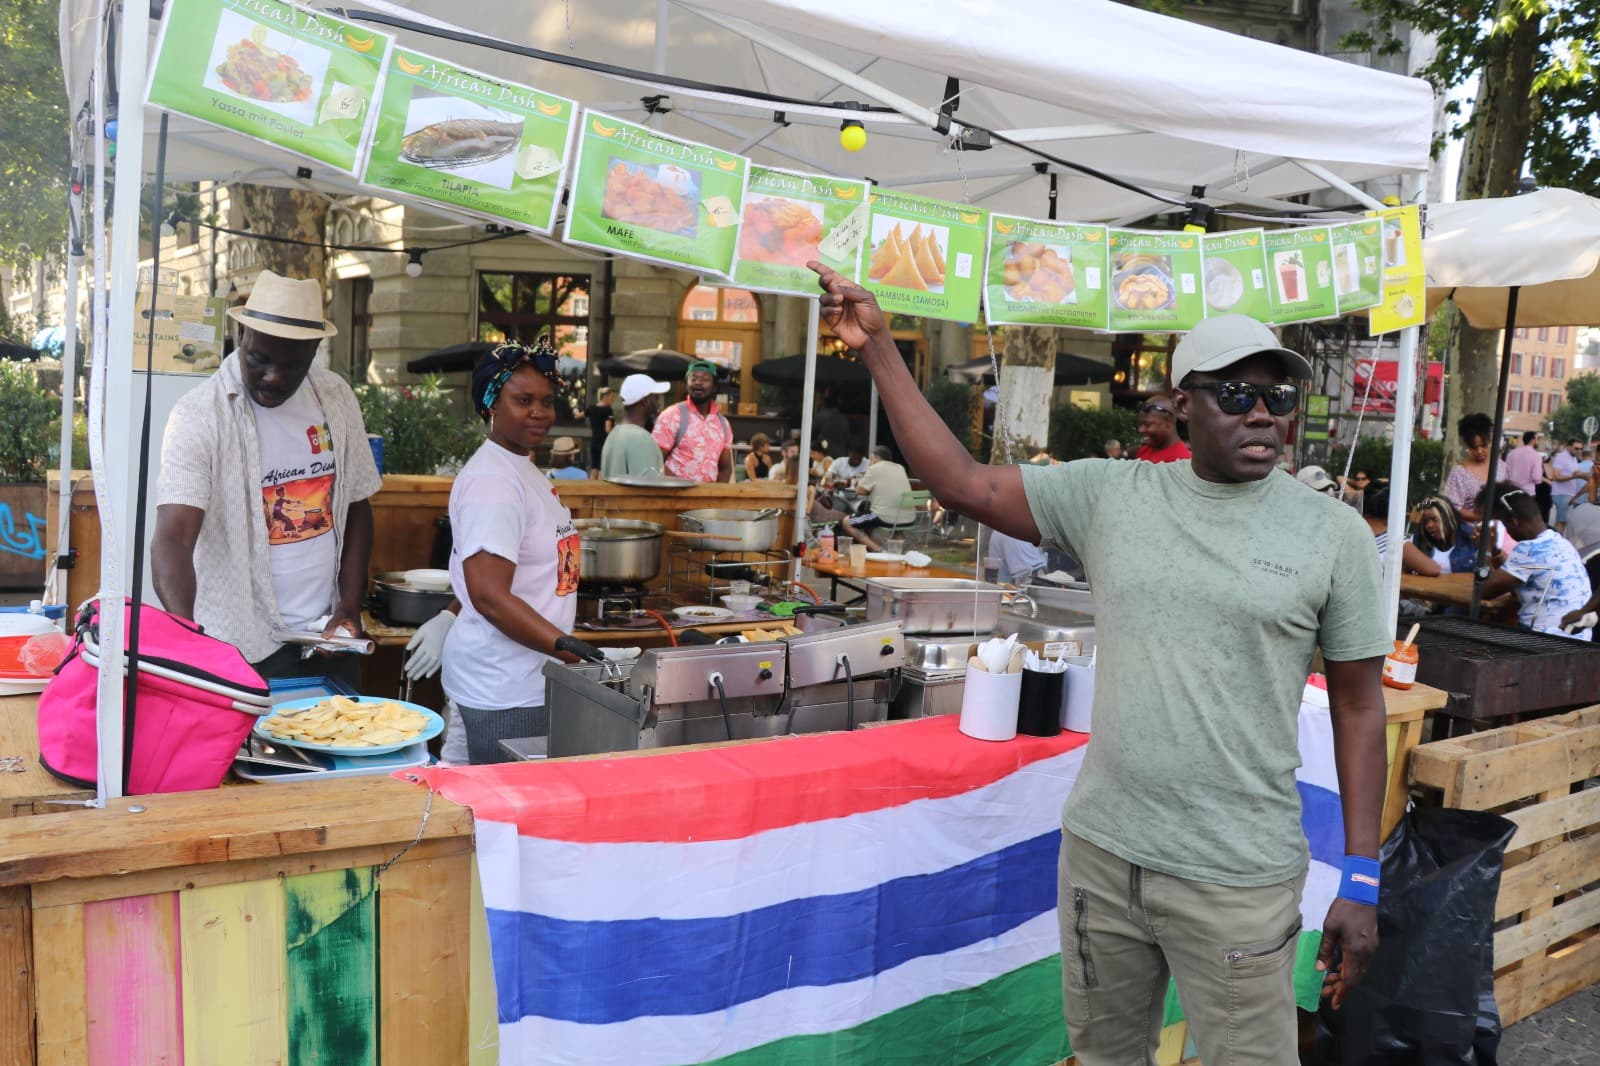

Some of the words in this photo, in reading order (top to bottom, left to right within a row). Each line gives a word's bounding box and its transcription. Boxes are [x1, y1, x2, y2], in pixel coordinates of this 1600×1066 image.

[230, 0, 296, 25] rican
[301, 15, 345, 43] Dish
[422, 63, 493, 96] African
[498, 87, 537, 109] Dish
[211, 97, 246, 117] Yassa
[249, 111, 267, 123] mit
[615, 126, 675, 154] African
[680, 146, 713, 165] Dish
[442, 178, 479, 197] TILAPIA
[748, 170, 796, 191] frican
[801, 178, 833, 196] Dish
[1012, 222, 1054, 241] African
[1057, 227, 1083, 241] Dish
[875, 289, 911, 302] SAMBUSA
[912, 295, 949, 310] (SAMOSA)
[132, 331, 180, 342] LATAINS
[261, 467, 306, 484] African
[310, 461, 336, 475] Dish
